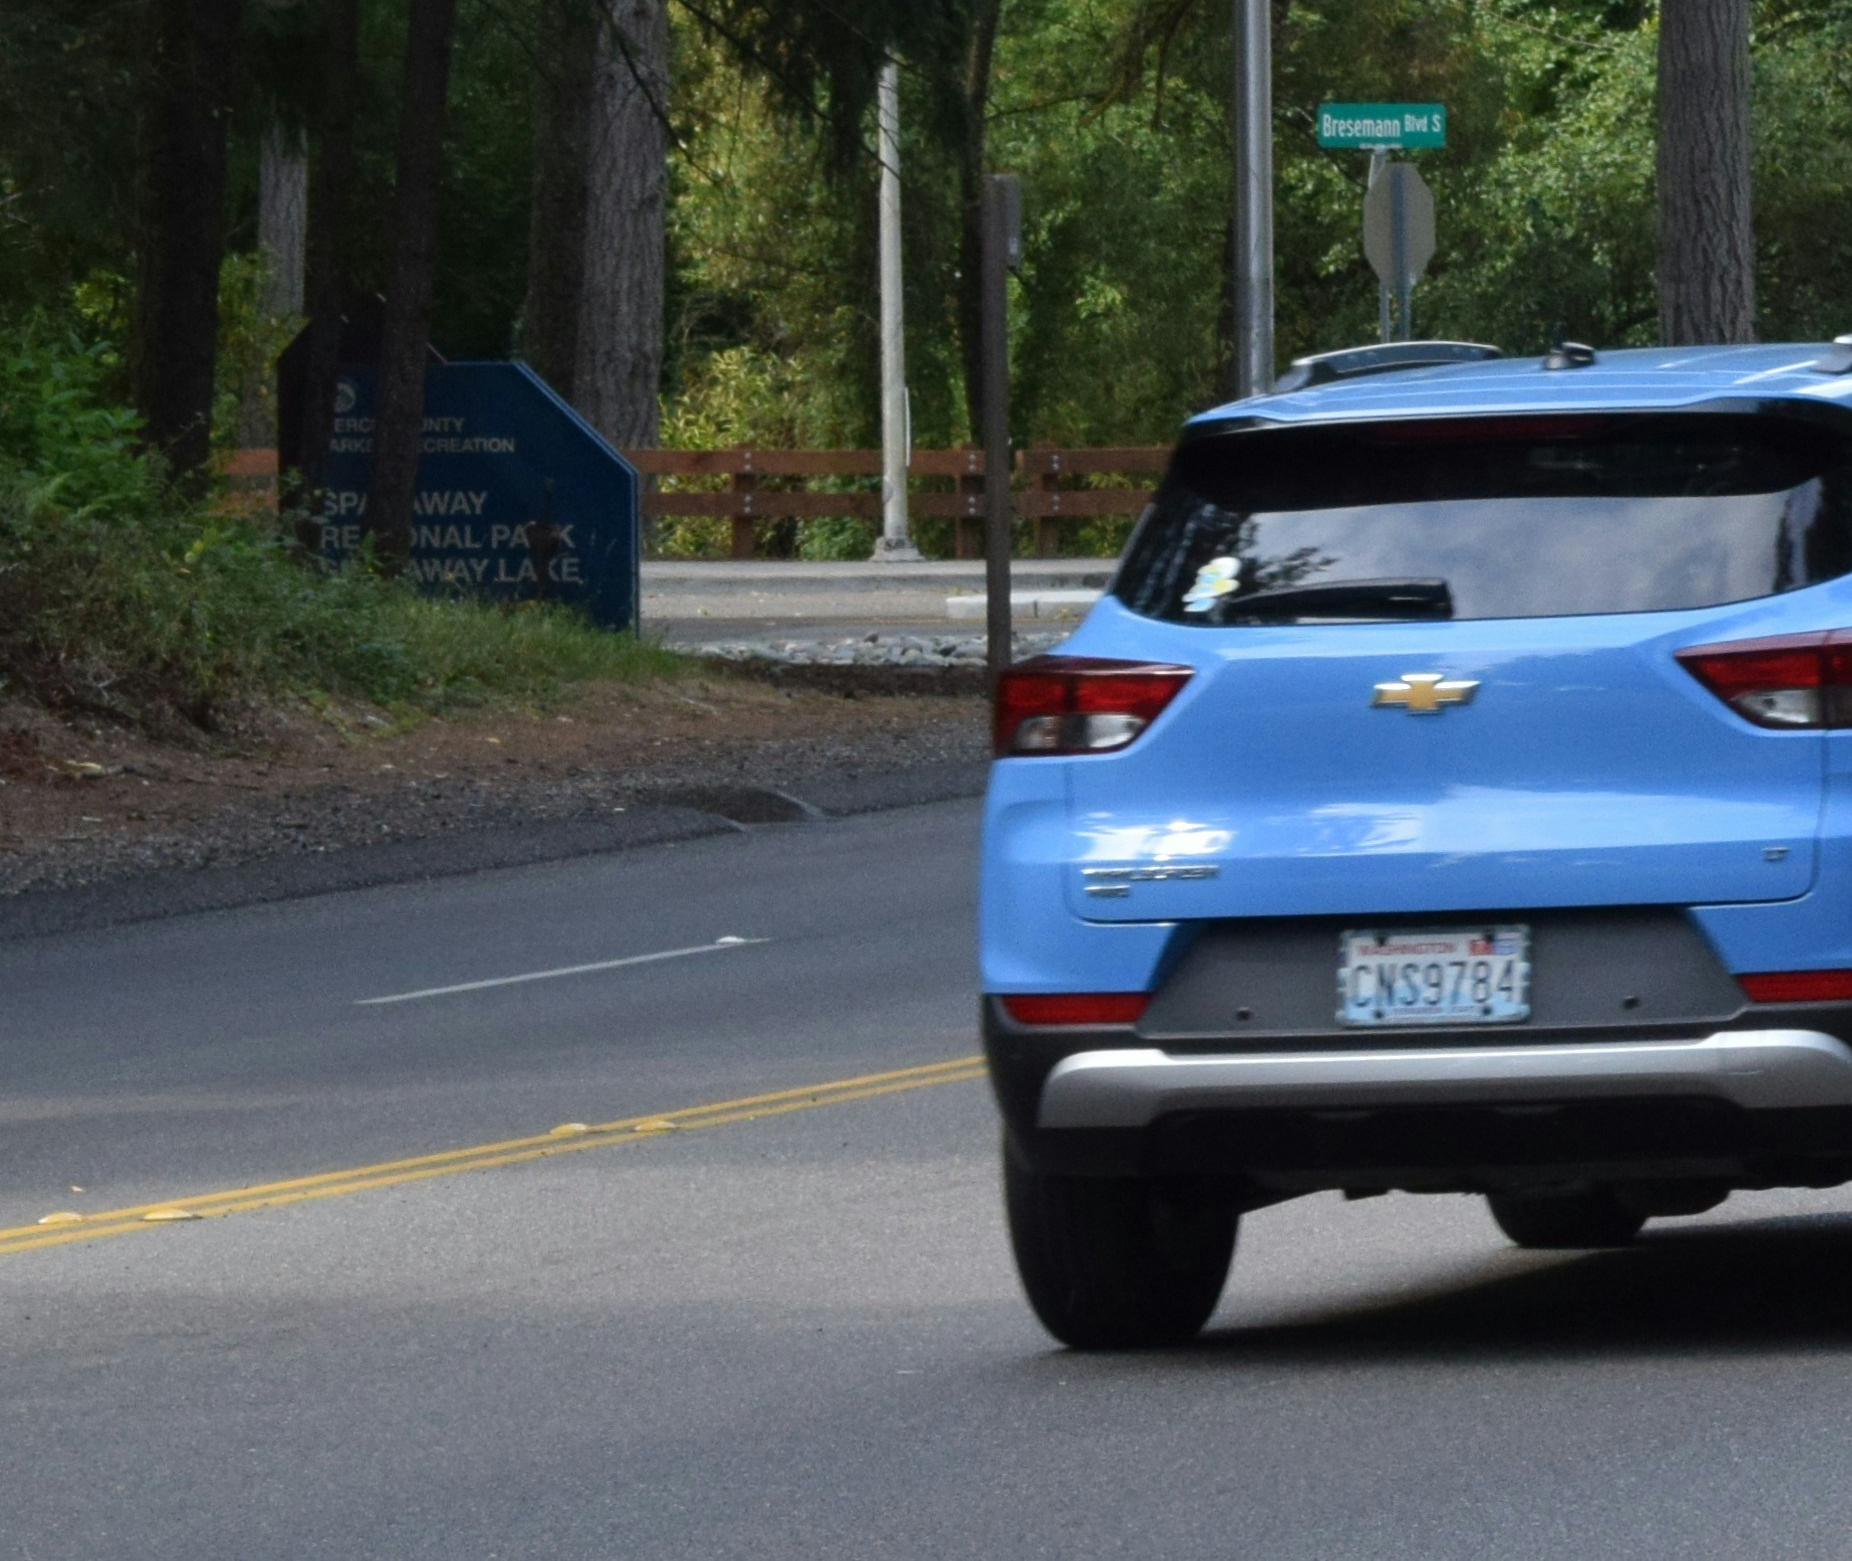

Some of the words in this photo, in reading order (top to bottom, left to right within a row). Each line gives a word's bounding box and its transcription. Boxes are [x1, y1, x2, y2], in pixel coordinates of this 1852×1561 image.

[1322, 114, 1401, 137] Bresemann
[1404, 114, 1428, 132] Blvd
[1432, 114, 1441, 132] S
[491, 523, 576, 549] PAK
[1353, 960, 1514, 1007] CNS9784
